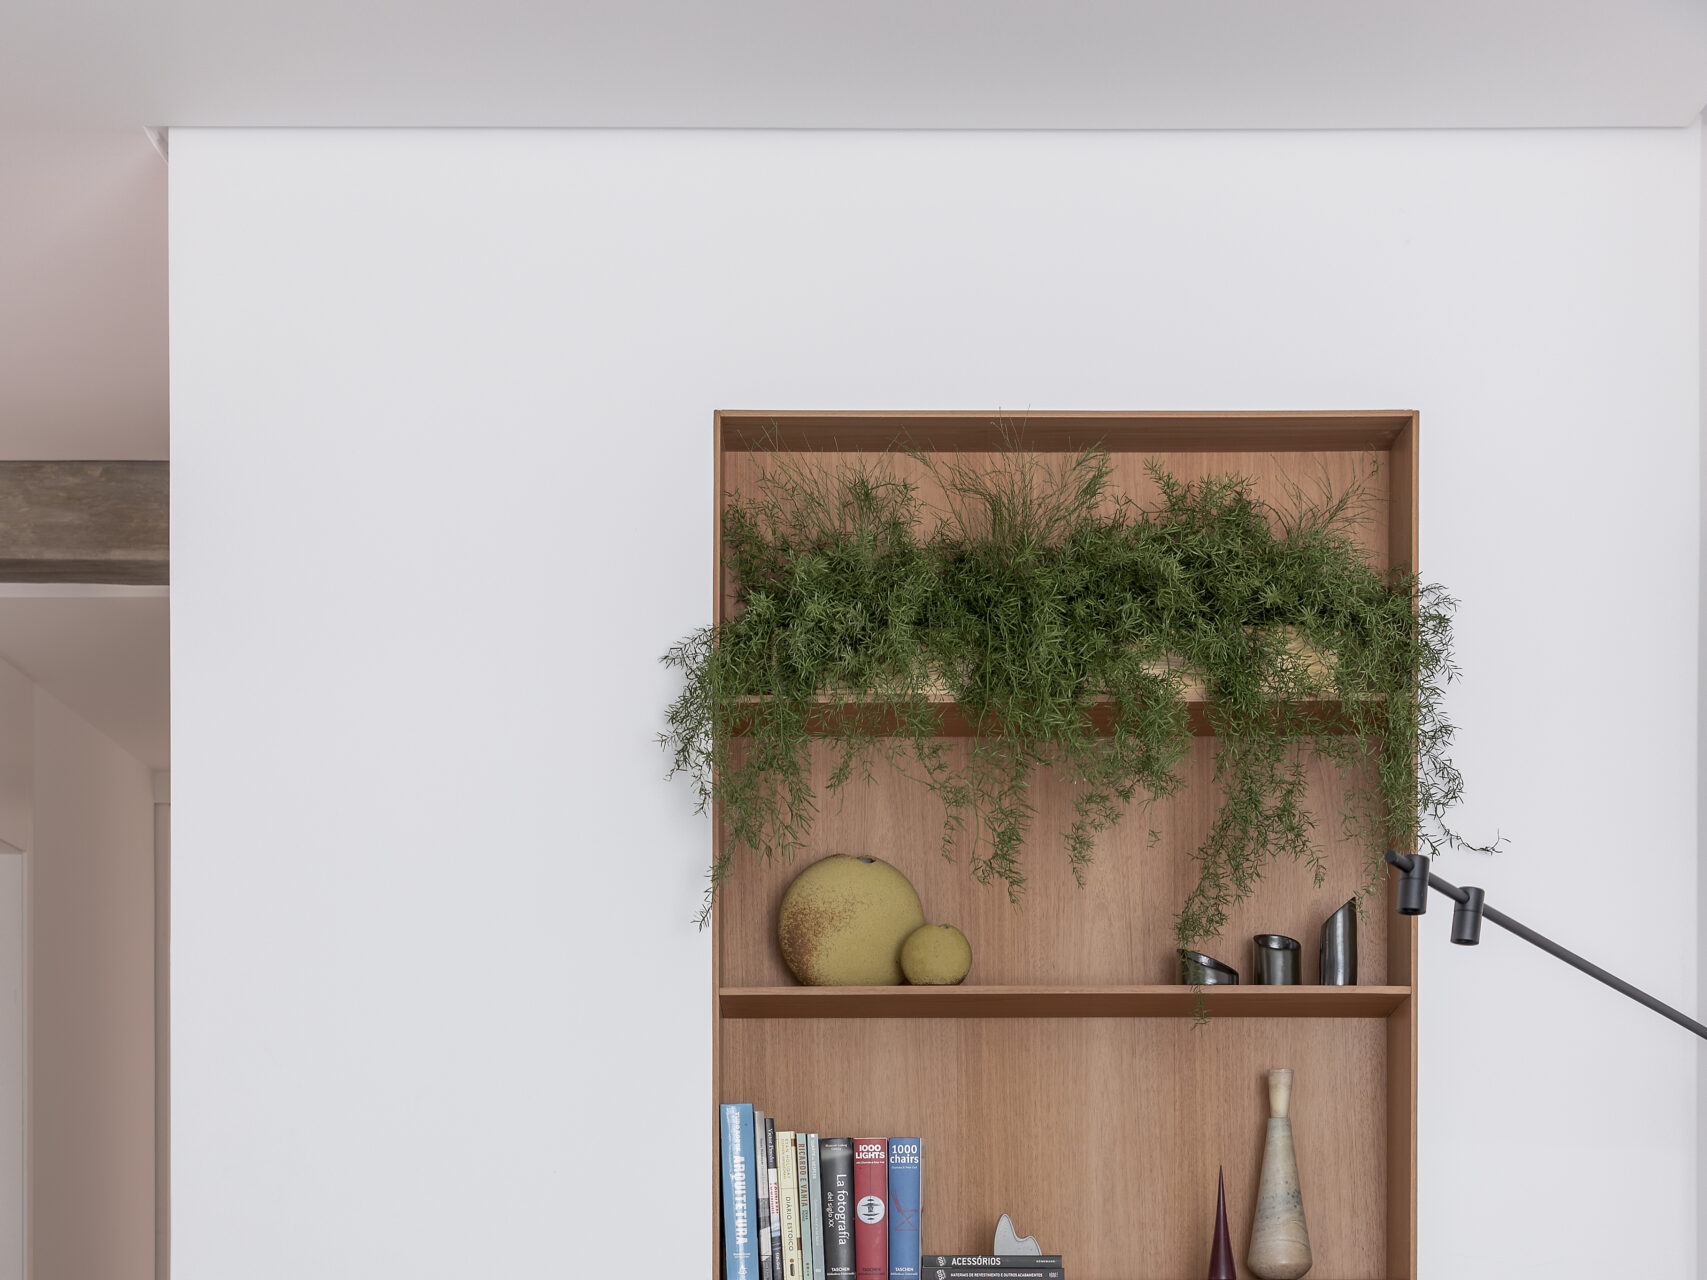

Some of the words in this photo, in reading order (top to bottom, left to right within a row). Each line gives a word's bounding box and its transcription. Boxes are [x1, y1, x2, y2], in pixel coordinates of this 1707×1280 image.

[855, 1151, 885, 1159] LIGHTS
[891, 1144, 917, 1154] 1000
[798, 1143, 807, 1176] RICARDO
[890, 1154, 919, 1164] chairs
[836, 1174, 847, 1187] La
[733, 1155, 748, 1245] ARQUITETURA
[826, 1202, 834, 1218] siglo
[828, 1218, 834, 1228] XX
[834, 1189, 850, 1245] fotografía
[951, 1255, 1001, 1266] ACESSÓRIOS
